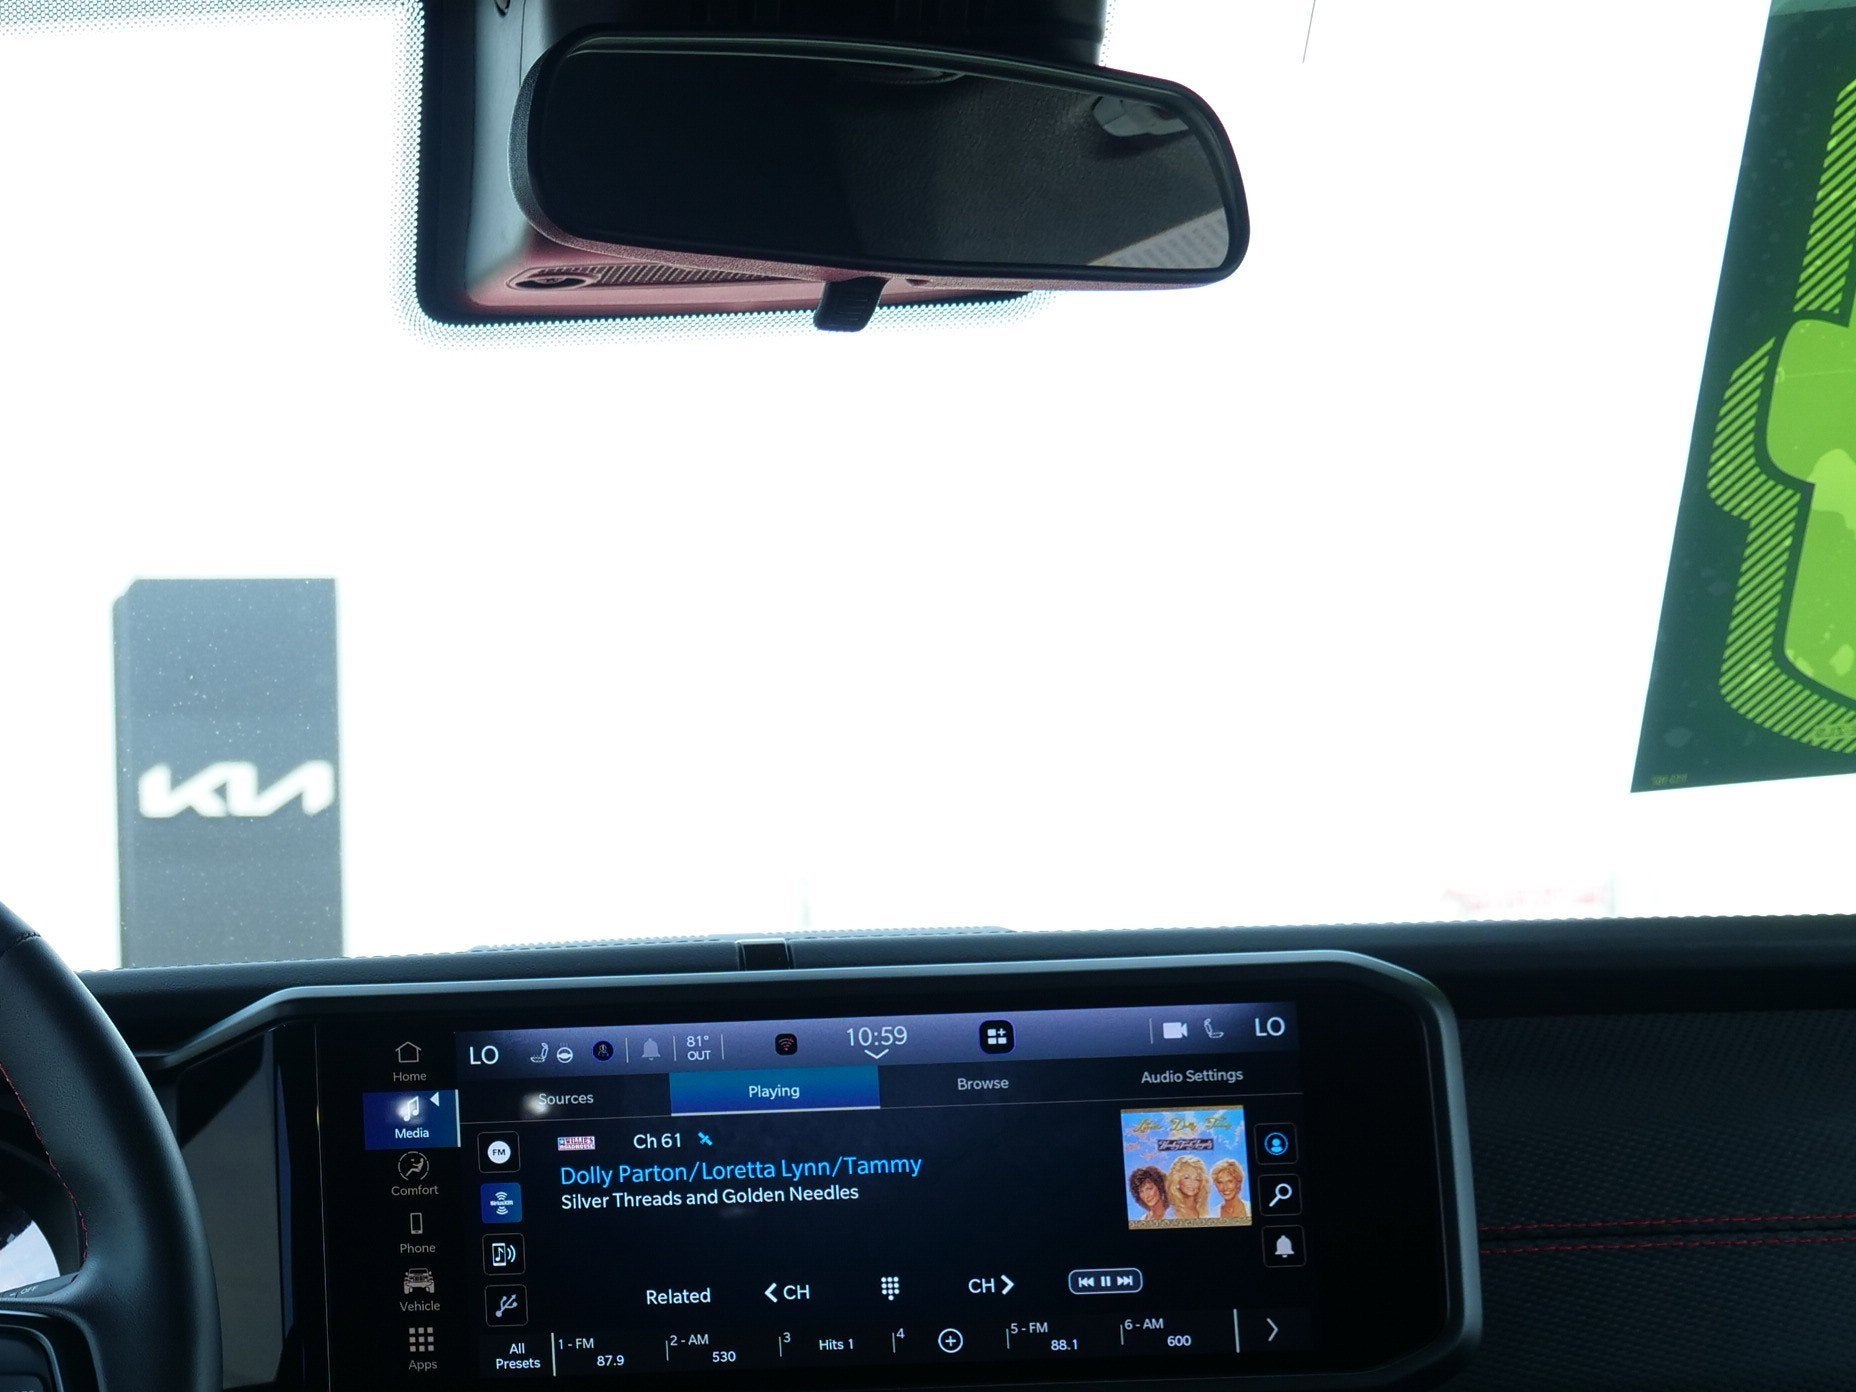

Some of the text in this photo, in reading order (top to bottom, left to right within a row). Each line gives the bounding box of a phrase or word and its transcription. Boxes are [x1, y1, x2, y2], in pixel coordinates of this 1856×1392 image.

[1254, 1017, 1285, 1037] LO
[846, 1025, 908, 1047] 10:59
[469, 1045, 499, 1065] LO
[687, 1050, 712, 1060] OUT
[393, 1072, 427, 1082] Home
[1141, 1067, 1244, 1085] Audio Settings
[957, 1076, 1009, 1091] Browse
[748, 1083, 800, 1100] Playing
[538, 1091, 594, 1107] Sources
[394, 1127, 430, 1139] Media
[633, 1133, 682, 1149] Ch 61
[560, 1157, 922, 1188] Dolly Parton/Loretta Lynn/Tammy
[391, 1183, 439, 1196] Comfort
[561, 1184, 859, 1210] Silver Threads and Golden Needles
[399, 1242, 436, 1253] Phone
[783, 1284, 810, 1300] CH
[968, 1278, 995, 1294] CH
[646, 1287, 711, 1304] Related
[399, 1300, 440, 1312] Vehicle
[1011, 1323, 1018, 1334] 5
[1030, 1322, 1048, 1334] FM
[1124, 1320, 1132, 1331] 6
[1143, 1318, 1164, 1330] AM
[669, 1335, 677, 1346] 2
[688, 1333, 709, 1345] AM
[783, 1332, 791, 1343] 3
[896, 1328, 905, 1339] 4
[558, 1339, 563, 1350] 1
[575, 1337, 594, 1349] FM
[819, 1338, 854, 1351] Hits 1
[1050, 1338, 1078, 1351] 88.1
[1167, 1334, 1192, 1347] 600
[509, 1342, 525, 1355] All
[495, 1356, 541, 1370] Presets
[596, 1354, 625, 1367] 87.9
[712, 1350, 737, 1363] 530
[408, 1359, 438, 1372] Apps
